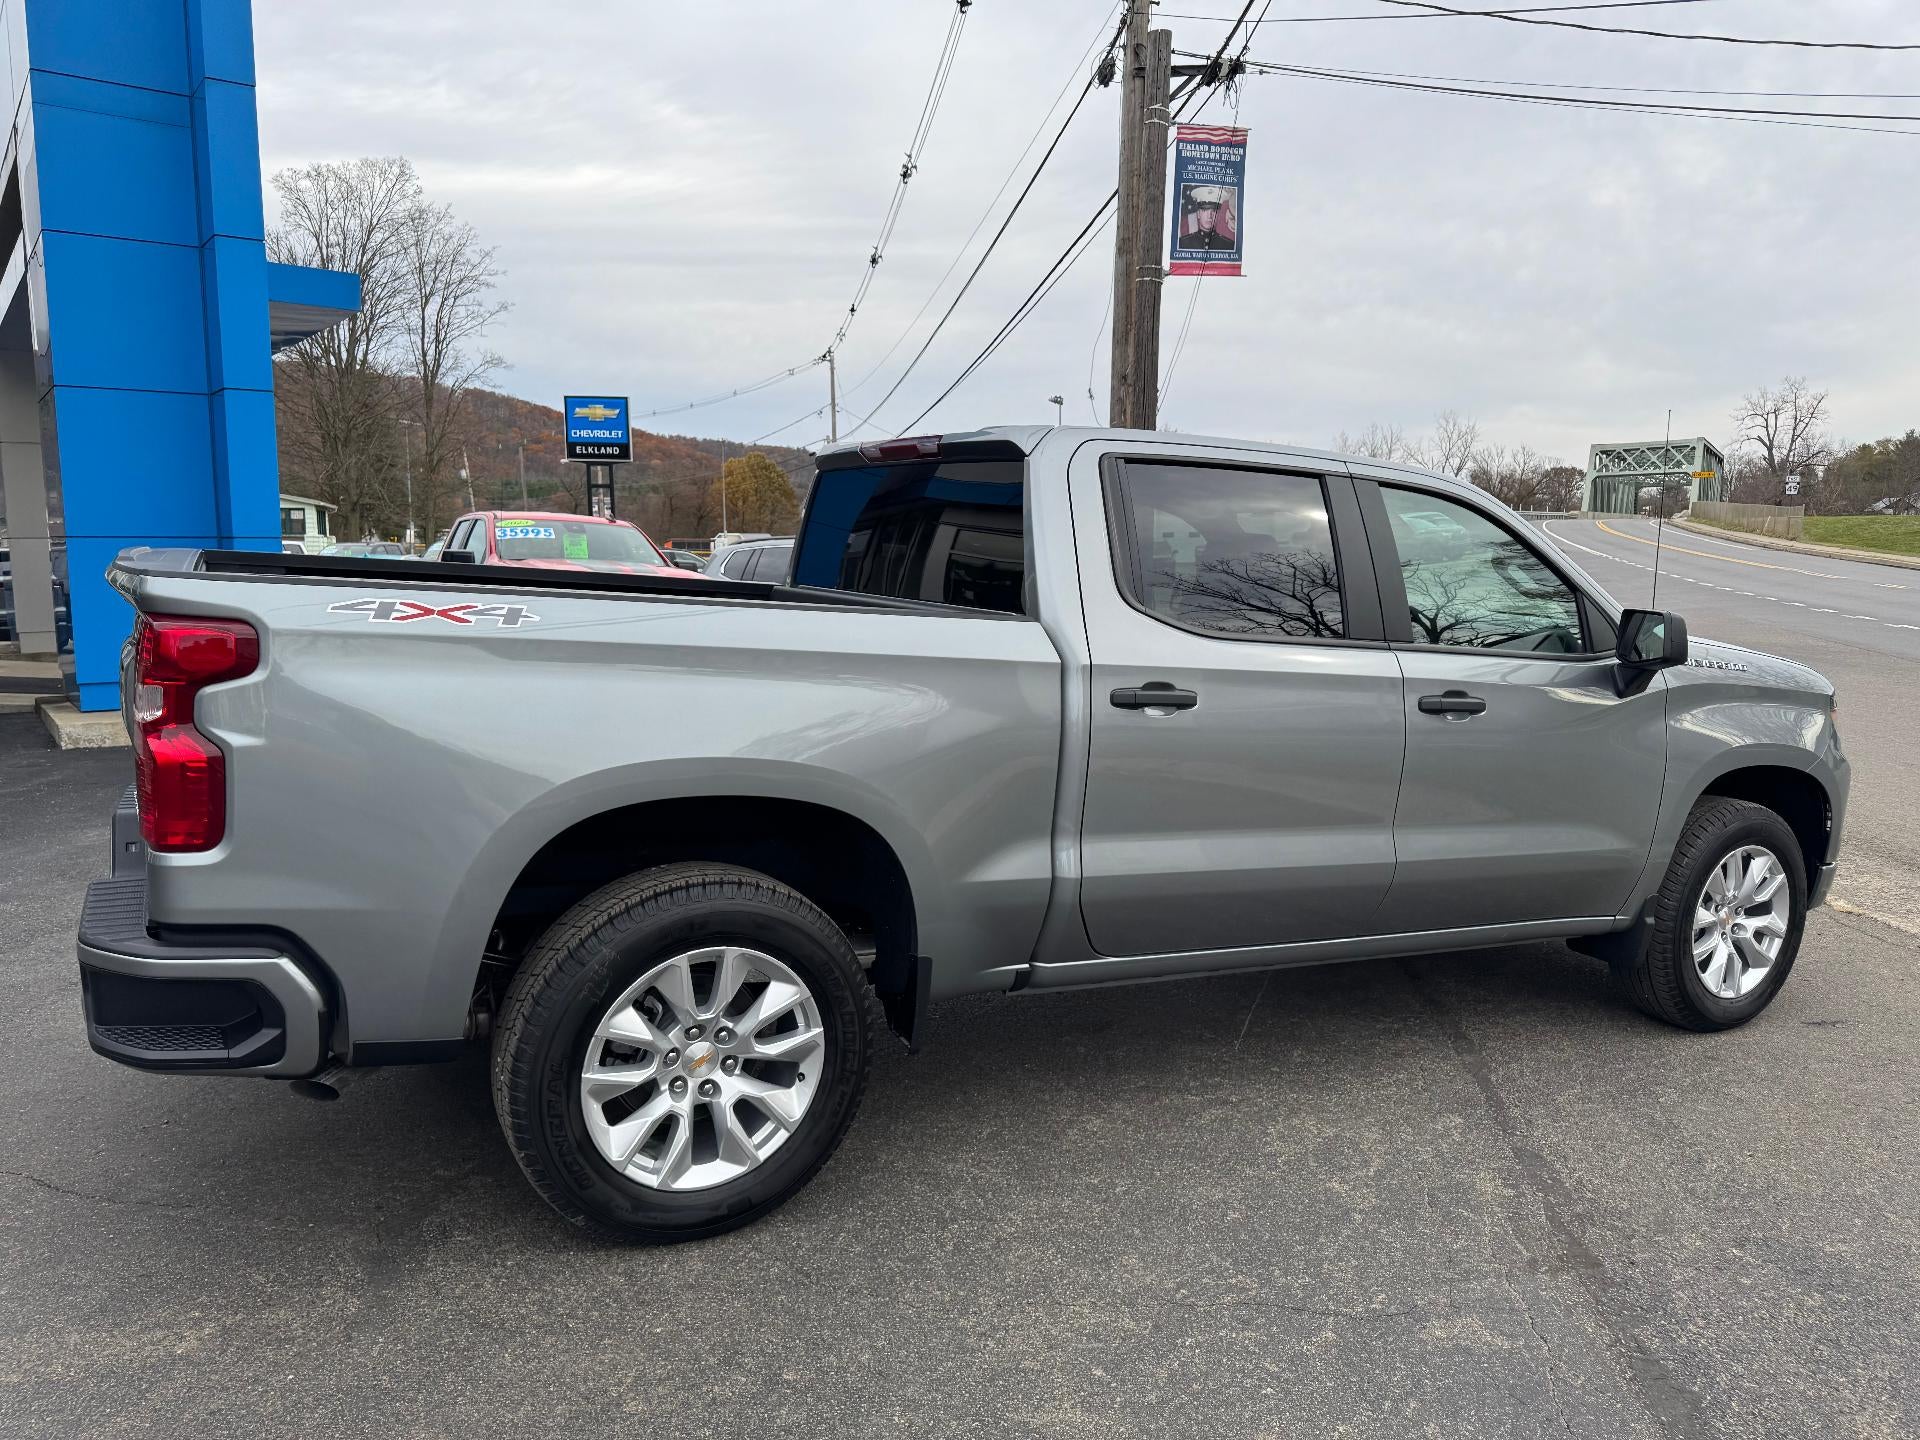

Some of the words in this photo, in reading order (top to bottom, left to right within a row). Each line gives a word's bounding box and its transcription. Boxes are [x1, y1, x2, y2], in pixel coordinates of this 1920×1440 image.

[1179, 143, 1208, 152] ELKLAND
[1210, 145, 1244, 155] BOROUGH
[1182, 150, 1220, 159] HOMETOWN
[1187, 165, 1214, 173] MICHAEL
[571, 429, 623, 438] CHEVROLET
[576, 445, 620, 454] ELKLAND
[497, 528, 553, 538] 35995
